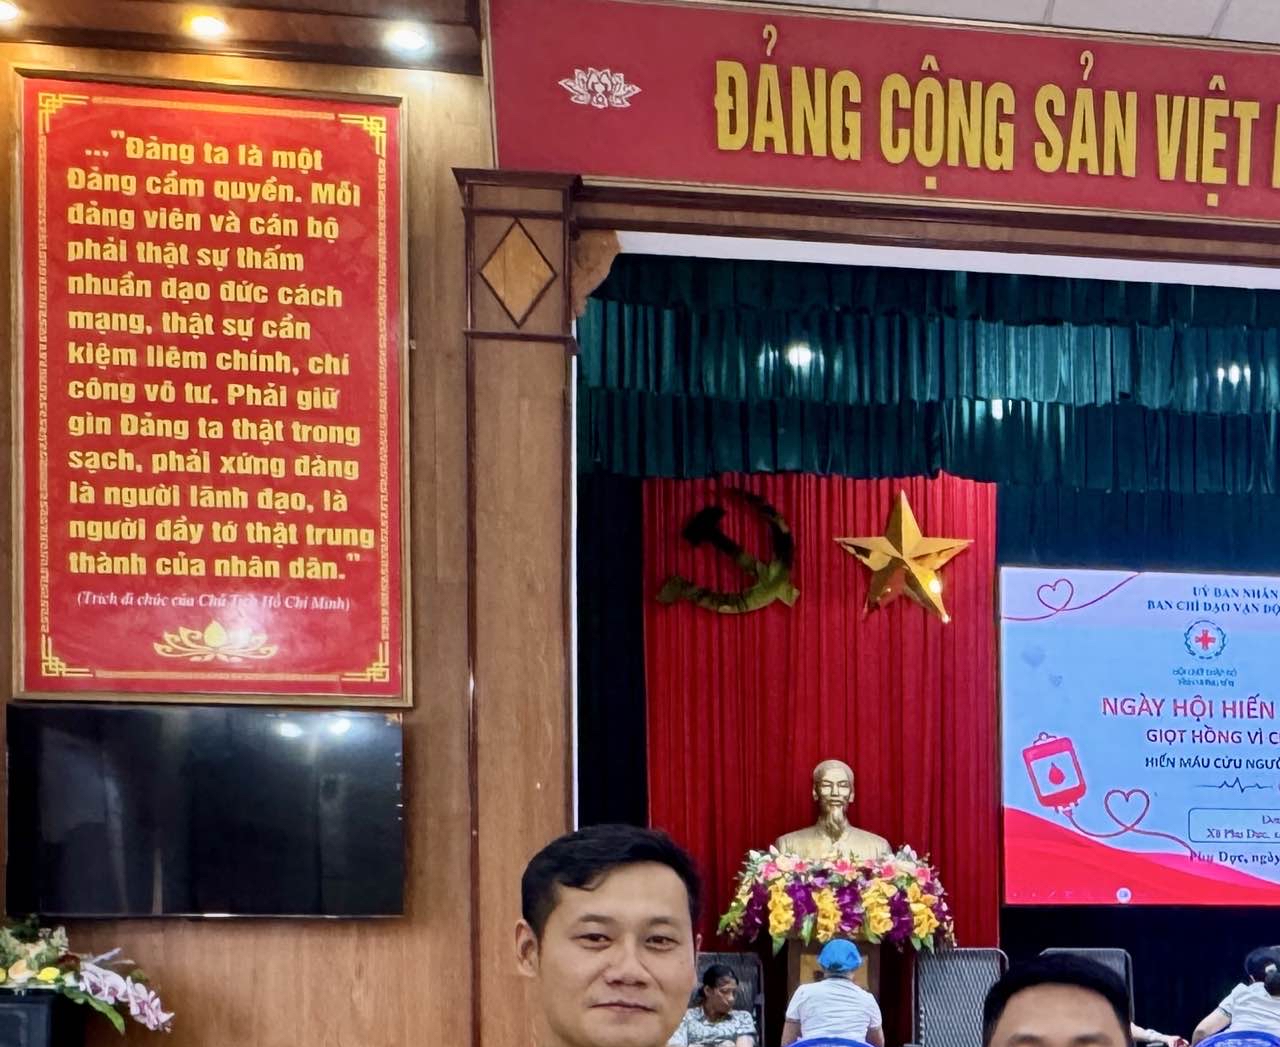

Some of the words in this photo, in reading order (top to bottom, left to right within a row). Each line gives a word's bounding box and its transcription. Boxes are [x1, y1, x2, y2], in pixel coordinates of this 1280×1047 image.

[715, 24, 861, 161] ĐẢNG
[881, 53, 1014, 190] CỘNG
[1035, 50, 1136, 178] SẢN
[1156, 75, 1259, 206] VIỆT
[203, 142, 229, 165] ta
[238, 143, 263, 166] là
[272, 148, 322, 174] một
[67, 167, 136, 195] Đảng
[68, 201, 134, 229] đảng
[144, 208, 200, 231] viên
[210, 211, 240, 234] và
[250, 214, 298, 237] cán
[308, 216, 339, 243] bộ
[68, 239, 126, 263] phải
[136, 242, 189, 270] thật
[197, 247, 229, 272] sự
[237, 245, 303, 271] thấm
[162, 278, 210, 304] đạo
[220, 280, 268, 303] đức
[278, 283, 342, 308] cách
[69, 310, 152, 334] mạng,
[162, 311, 214, 339] thật
[223, 317, 254, 341] sự
[69, 342, 137, 370] kiệm
[147, 345, 206, 370] liêm
[216, 350, 299, 375] chính,
[309, 352, 349, 375] chí
[69, 377, 135, 404] công
[144, 381, 175, 402] vô
[185, 383, 218, 404] tư.
[228, 383, 286, 406] Phải
[297, 387, 340, 410] giữ
[69, 412, 111, 437] gìn
[121, 412, 189, 440] Đảng
[198, 418, 223, 439] ta
[232, 418, 283, 445] thật
[291, 421, 360, 447] trong
[68, 449, 142, 474] sạch,
[152, 448, 210, 474] phải
[220, 453, 285, 478] xứng
[70, 481, 94, 503] là
[105, 484, 180, 508] người
[191, 486, 248, 509] lãnh
[258, 488, 314, 514] đạo,
[324, 489, 347, 512] là
[70, 518, 145, 541] người
[212, 521, 238, 542] tớ
[246, 522, 298, 549] thật
[306, 524, 374, 549] trung
[69, 551, 146, 575] thành
[156, 551, 205, 577] của
[215, 556, 280, 578] nhân
[1102, 693, 1165, 717] NGÀY
[1173, 695, 1213, 722] HỘI
[1222, 693, 1274, 719] HIẾN
[1147, 729, 1186, 745] GIỌT
[1192, 724, 1242, 744] HỒNG
[1248, 728, 1262, 744] VÌ
[1145, 753, 1175, 768] HIẾN
[1180, 755, 1210, 769] MÁU
